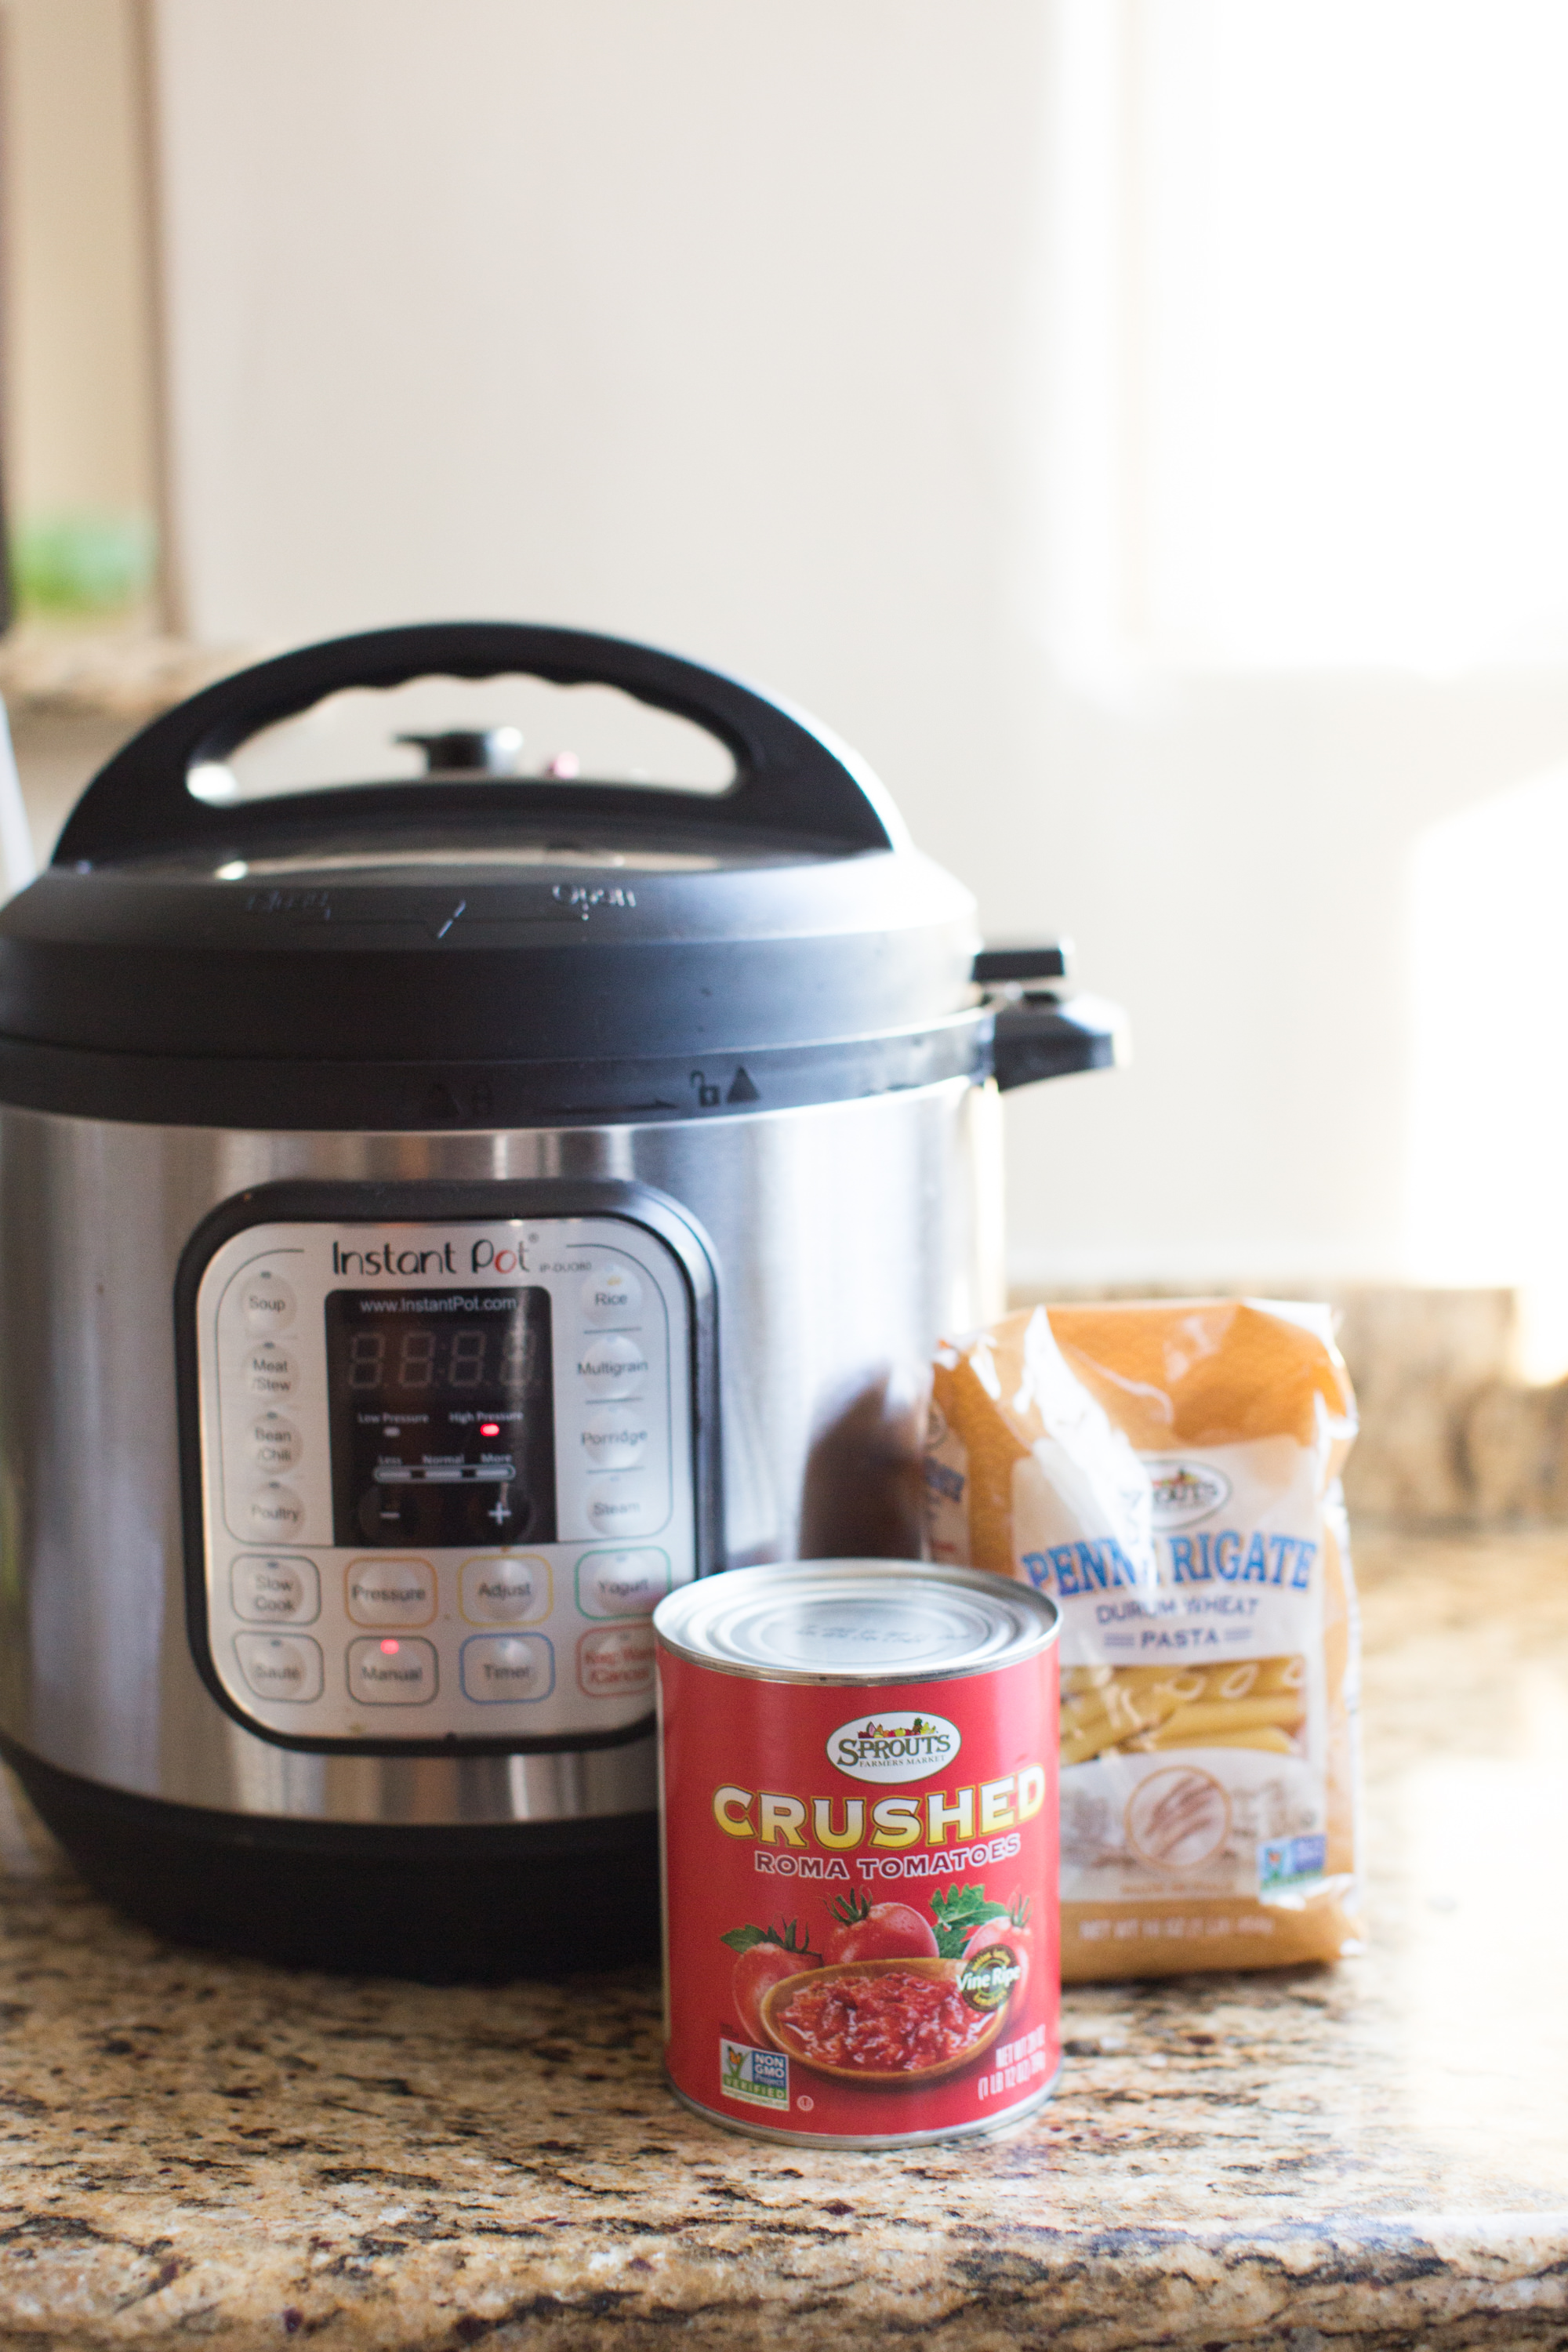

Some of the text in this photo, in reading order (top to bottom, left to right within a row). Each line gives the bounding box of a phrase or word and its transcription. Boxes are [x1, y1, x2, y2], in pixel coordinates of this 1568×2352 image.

[332, 1239, 531, 1276] Instant Pot
[248, 1296, 286, 1312] Soup
[359, 1295, 517, 1313] www.InstantPot.com
[594, 1292, 628, 1306] Rice
[252, 1358, 288, 1372] Meat
[577, 1359, 648, 1377] Multigrain
[358, 1413, 430, 1424] Low Pressure
[448, 1411, 524, 1425] High Pressure
[254, 1428, 292, 1443] Bean
[581, 1430, 648, 1446] Porridge
[422, 1454, 464, 1465] Normal
[480, 1454, 512, 1463] More
[251, 1504, 299, 1523] Poultry
[1022, 1530, 1318, 1597] PENN RIGATE
[351, 1584, 426, 1602] Pressure
[477, 1581, 532, 1600] Adjust
[1141, 1628, 1221, 1648] PASTA
[361, 1664, 423, 1681] Manual
[837, 1734, 951, 1767] SPROUTS
[859, 1754, 946, 1768] FARMERS MARKET
[712, 1763, 1047, 1852] CRUSHED
[754, 1833, 1022, 1880] ROMA TOMATOES
[955, 1964, 1021, 1991] Vine Ripe
[755, 2053, 784, 2068] NON
[755, 2064, 785, 2078] GMO
[724, 2078, 785, 2100] VERIFIED
